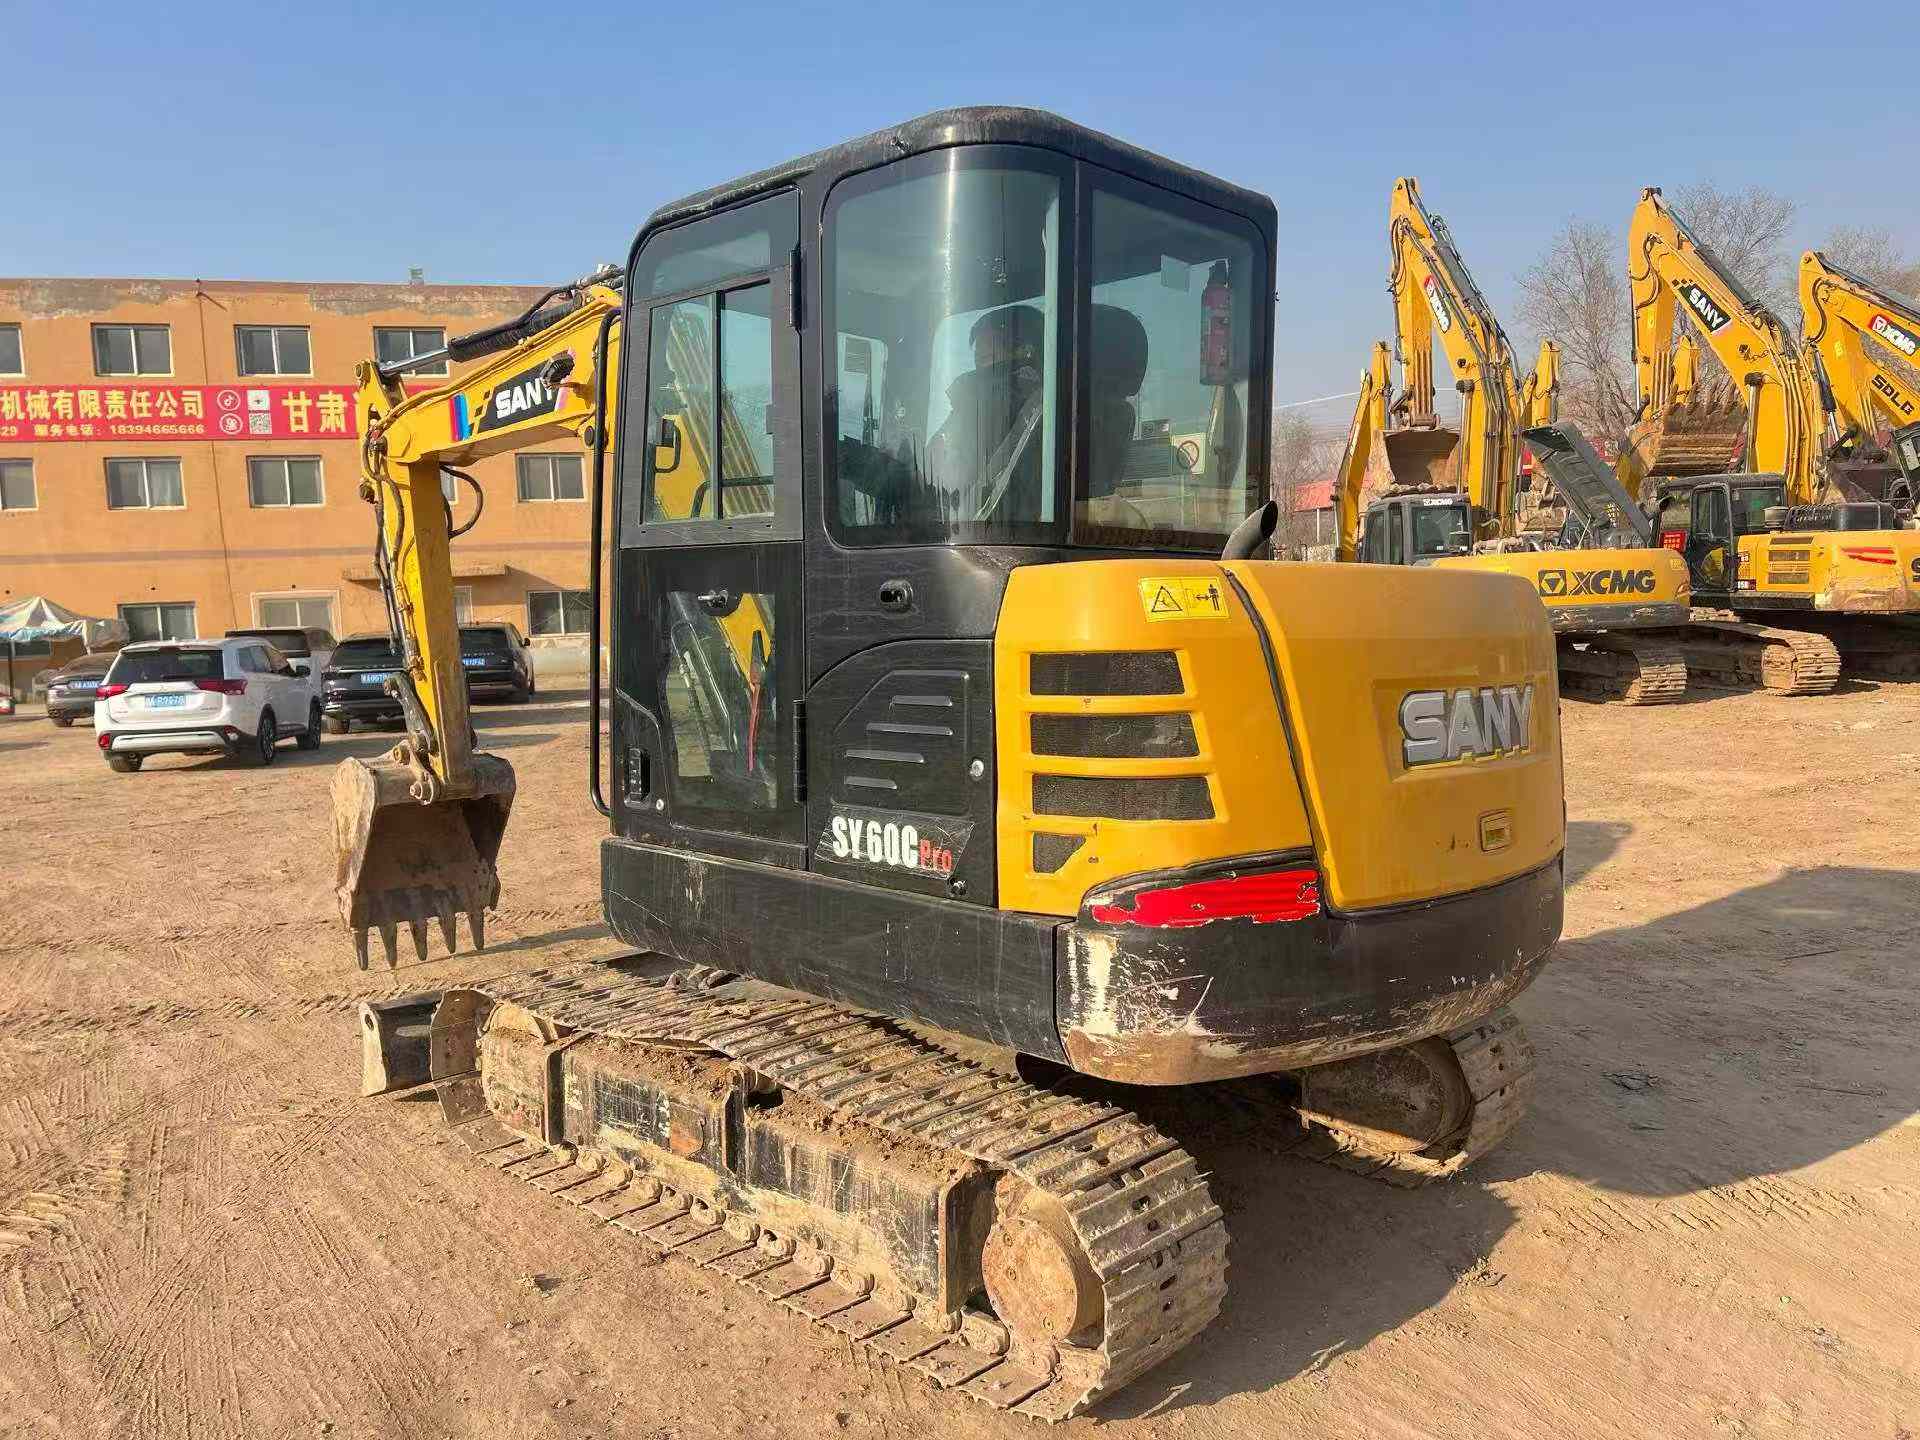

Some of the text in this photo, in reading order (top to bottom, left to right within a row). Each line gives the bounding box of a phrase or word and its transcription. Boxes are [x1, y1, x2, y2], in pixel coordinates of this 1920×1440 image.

[1429, 293, 1450, 332] XCMG
[1689, 287, 1724, 328] SANY
[1882, 324, 1916, 355] XCMG
[0, 389, 203, 420] 机械有限责任公司
[281, 389, 360, 433] 甘肃
[1568, 569, 1657, 596] XCMG
[1399, 684, 1534, 769] SANY
[831, 815, 953, 872] SY60C Pro
